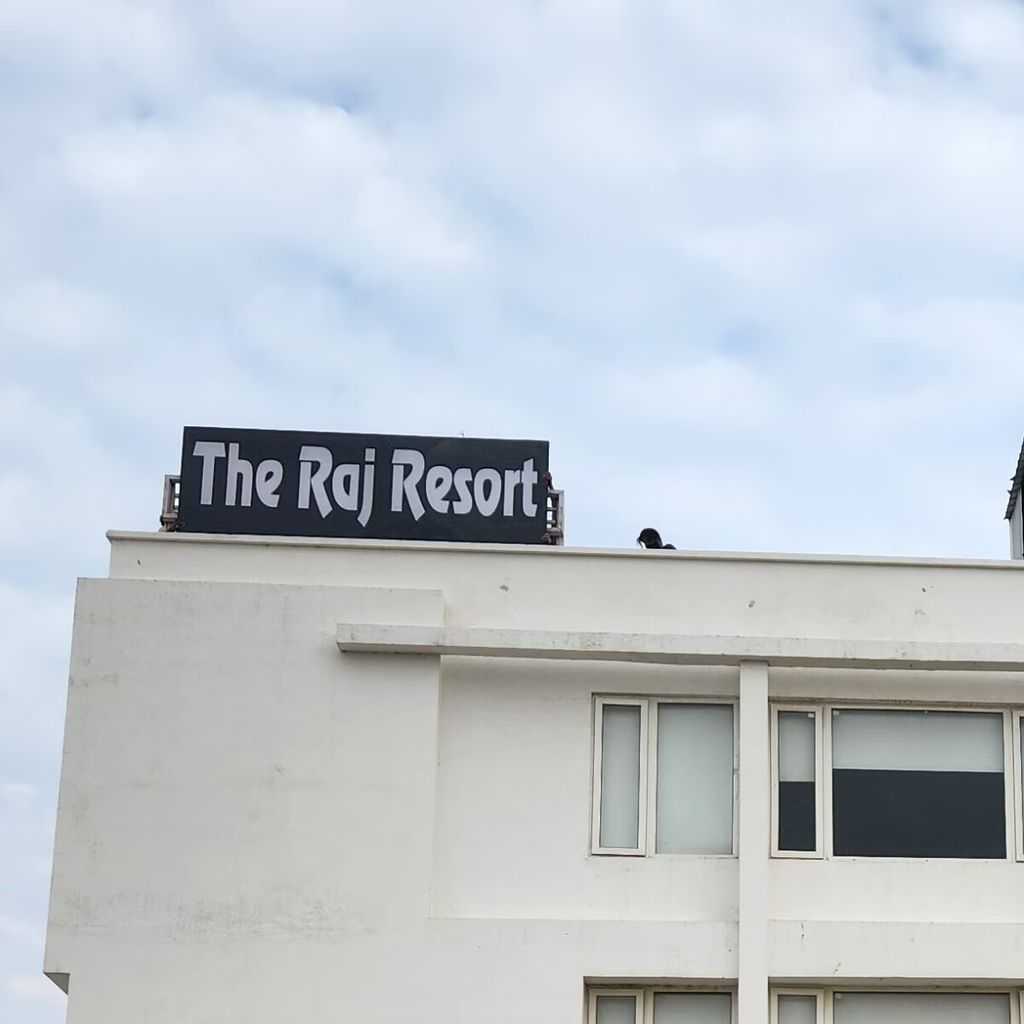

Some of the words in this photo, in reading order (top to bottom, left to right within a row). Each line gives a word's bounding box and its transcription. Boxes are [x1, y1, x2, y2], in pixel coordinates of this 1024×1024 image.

[193, 441, 283, 508] The
[298, 445, 375, 528] Raj
[391, 449, 538, 521] Resort
